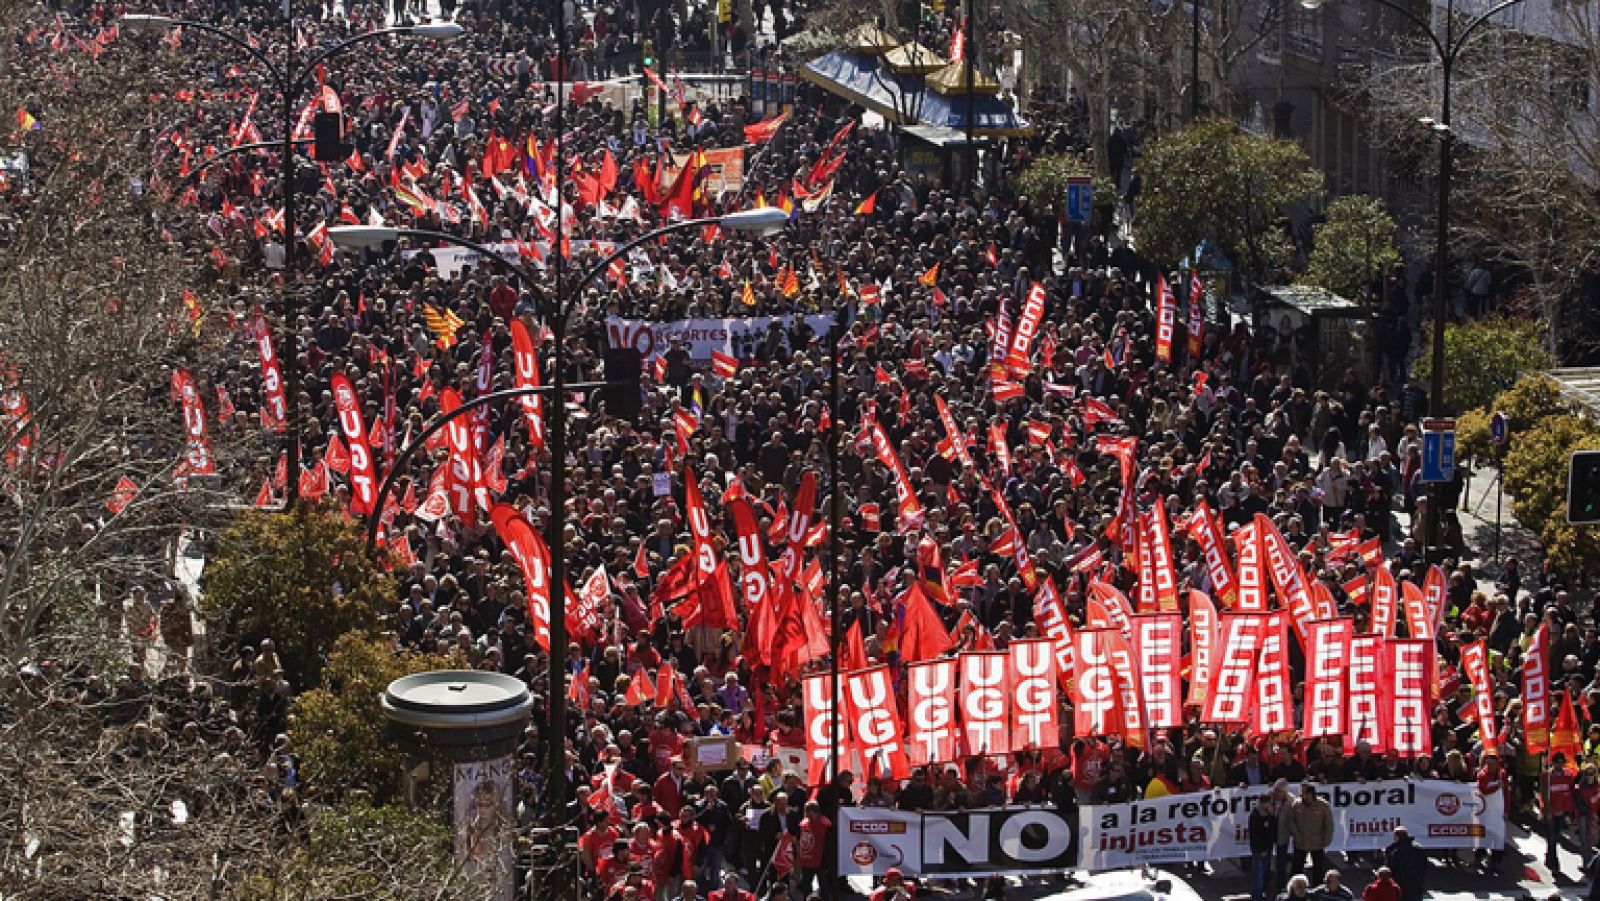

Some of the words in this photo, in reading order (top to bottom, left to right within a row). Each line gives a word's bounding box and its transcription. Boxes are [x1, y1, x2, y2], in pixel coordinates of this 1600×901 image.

[914, 662, 949, 762] UGT
[966, 656, 1003, 751] UGT
[1016, 641, 1051, 748] UGT
[1078, 632, 1115, 734] UGT
[1141, 622, 1172, 727] CCOO
[1212, 618, 1260, 719] CCOO
[1312, 625, 1344, 736] CCOO
[1350, 638, 1379, 746] CCOO
[1394, 643, 1424, 751] CCOO
[809, 673, 845, 784] UGT
[850, 671, 899, 776] UGT
[924, 810, 1072, 865] NO
[1100, 812, 1119, 829] a
[1130, 804, 1157, 825] la
[1100, 822, 1207, 854] injusta
[1349, 817, 1401, 833] inútil
